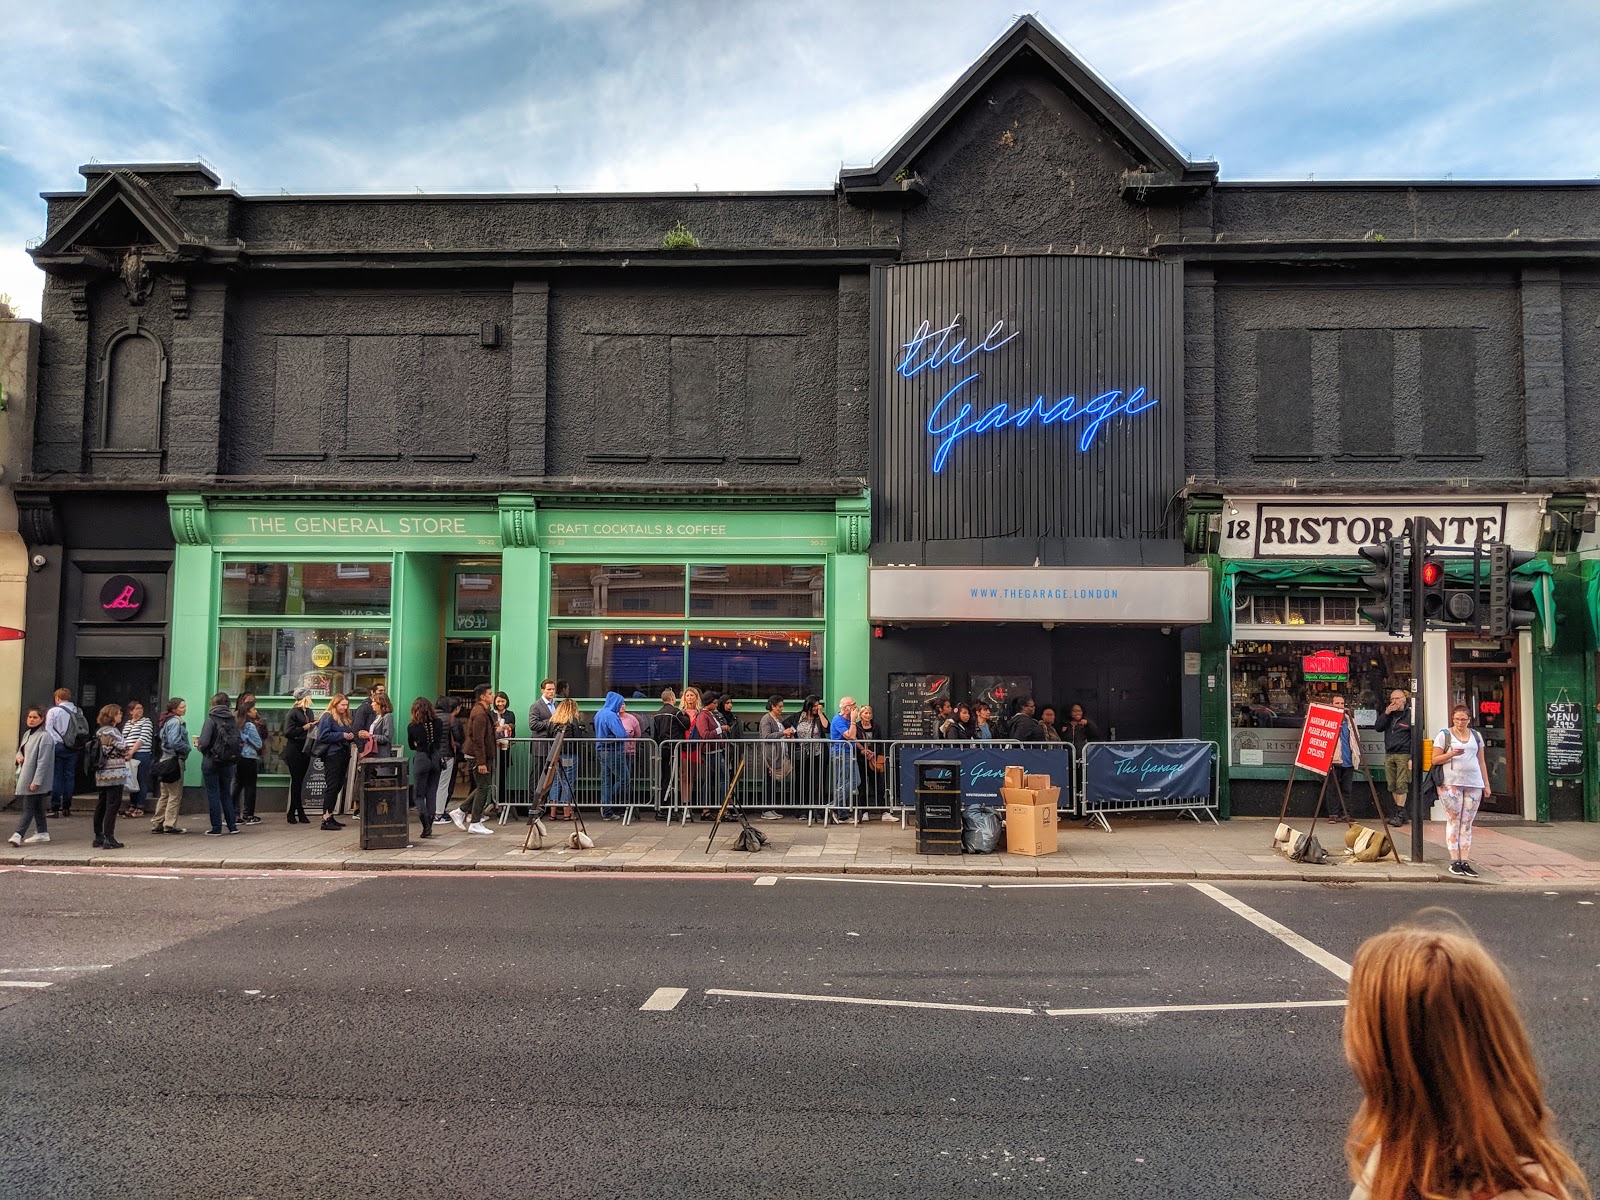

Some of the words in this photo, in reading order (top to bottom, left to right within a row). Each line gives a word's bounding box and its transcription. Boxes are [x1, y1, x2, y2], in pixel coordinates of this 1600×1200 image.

[897, 313, 1020, 377] the
[928, 373, 1160, 473] Garage
[248, 517, 287, 533] THE
[295, 517, 391, 533] GENERAL
[399, 517, 466, 533] STORE
[548, 524, 589, 534] CRAFT
[593, 524, 662, 535] COCKTAILS
[665, 524, 674, 535] &
[677, 524, 726, 535] COFFEE
[1226, 519, 1251, 540] 18
[1262, 516, 1497, 545] RISTORANTE
[970, 588, 1119, 599] WWW.THEGARAGE.LONDON
[1480, 701, 1501, 713] OPEN
[1549, 703, 1575, 713] SET
[1547, 712, 1579, 722] MENU
[1325, 719, 1338, 730] LANES
[1308, 726, 1321, 736] PLEASE
[1326, 730, 1336, 740] NOT
[1309, 737, 1328, 749] OVERTAKE
[1307, 747, 1325, 759] CYCLISTS
[1114, 757, 1138, 776] The
[1140, 756, 1185, 782] Garage
